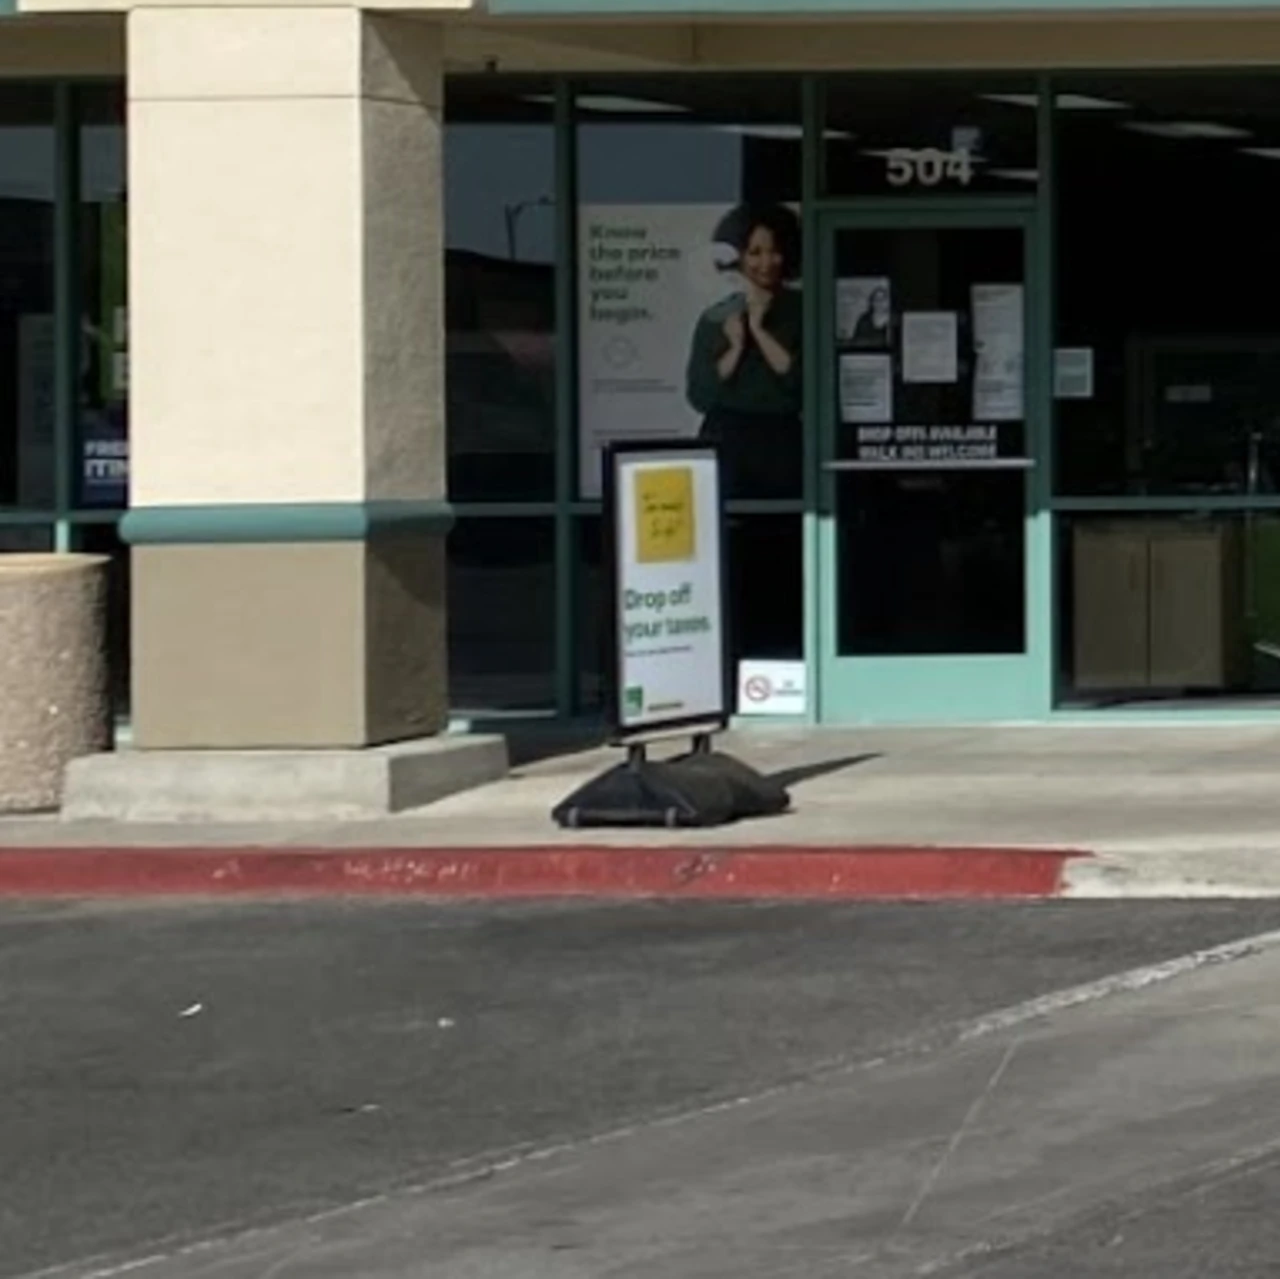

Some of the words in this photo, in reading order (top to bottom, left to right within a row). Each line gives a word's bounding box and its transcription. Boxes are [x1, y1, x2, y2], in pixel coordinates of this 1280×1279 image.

[886, 147, 974, 186] 504
[627, 242, 682, 262] price
[624, 588, 667, 613] Drop
[669, 582, 692, 605] off
[623, 622, 663, 643] your
